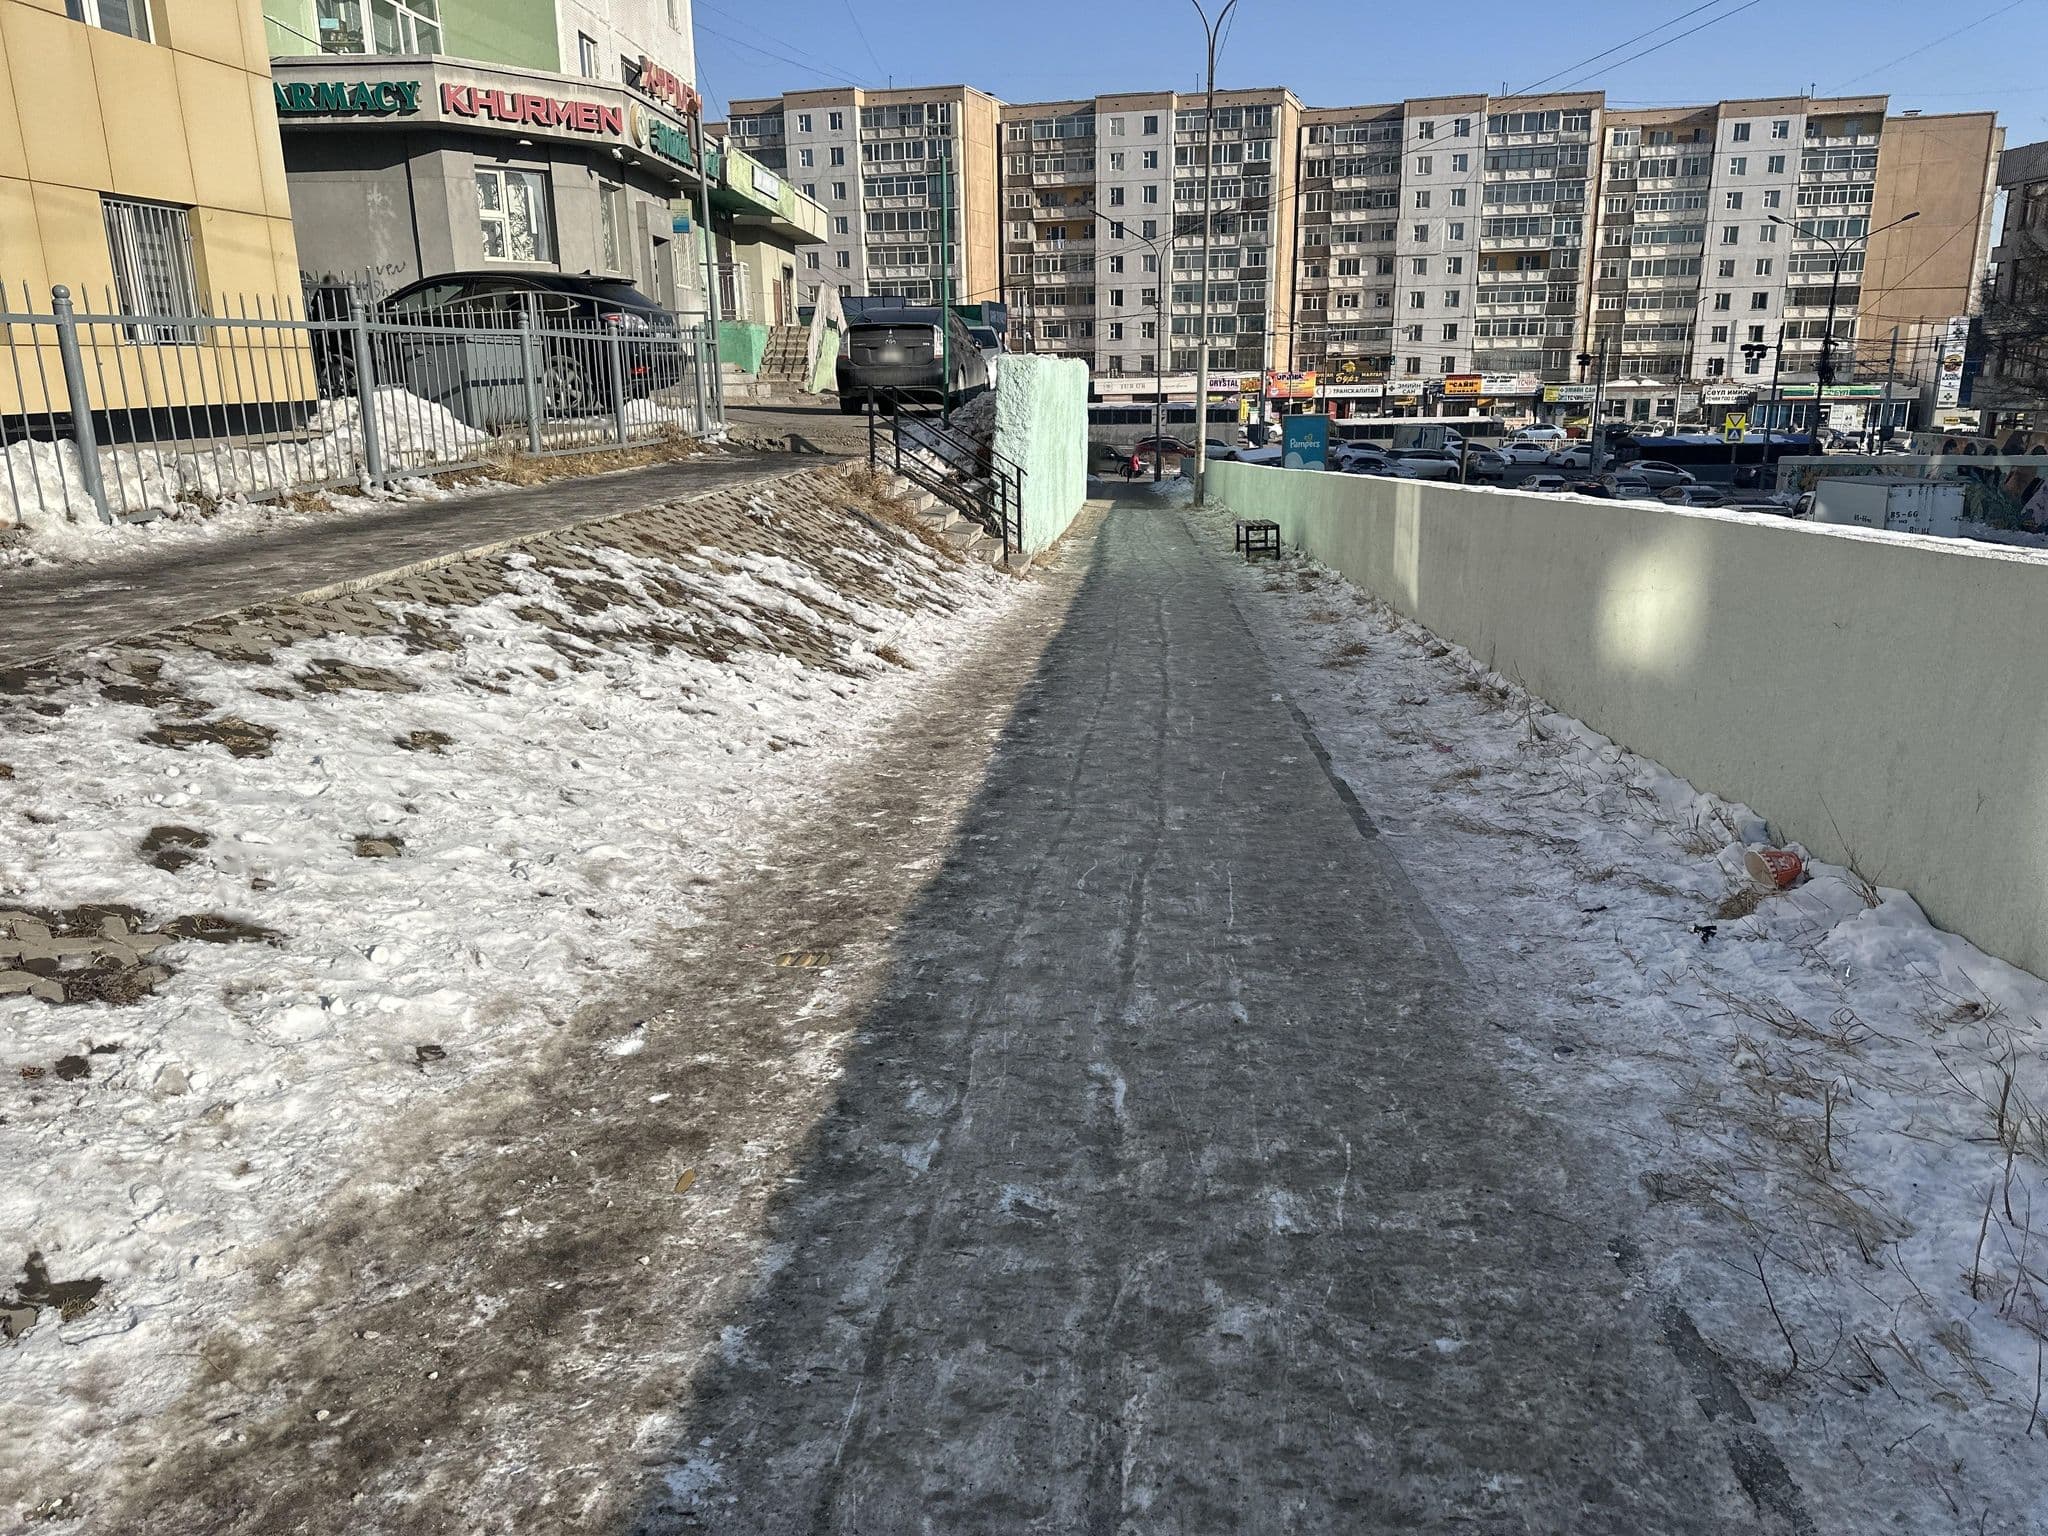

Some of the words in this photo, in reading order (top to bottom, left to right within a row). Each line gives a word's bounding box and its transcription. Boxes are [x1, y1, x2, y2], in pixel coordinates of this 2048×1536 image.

[440, 82, 624, 136] KHURMEN
[1209, 379, 1239, 387] CRYSTAL
[1290, 438, 1321, 449] Pampers
